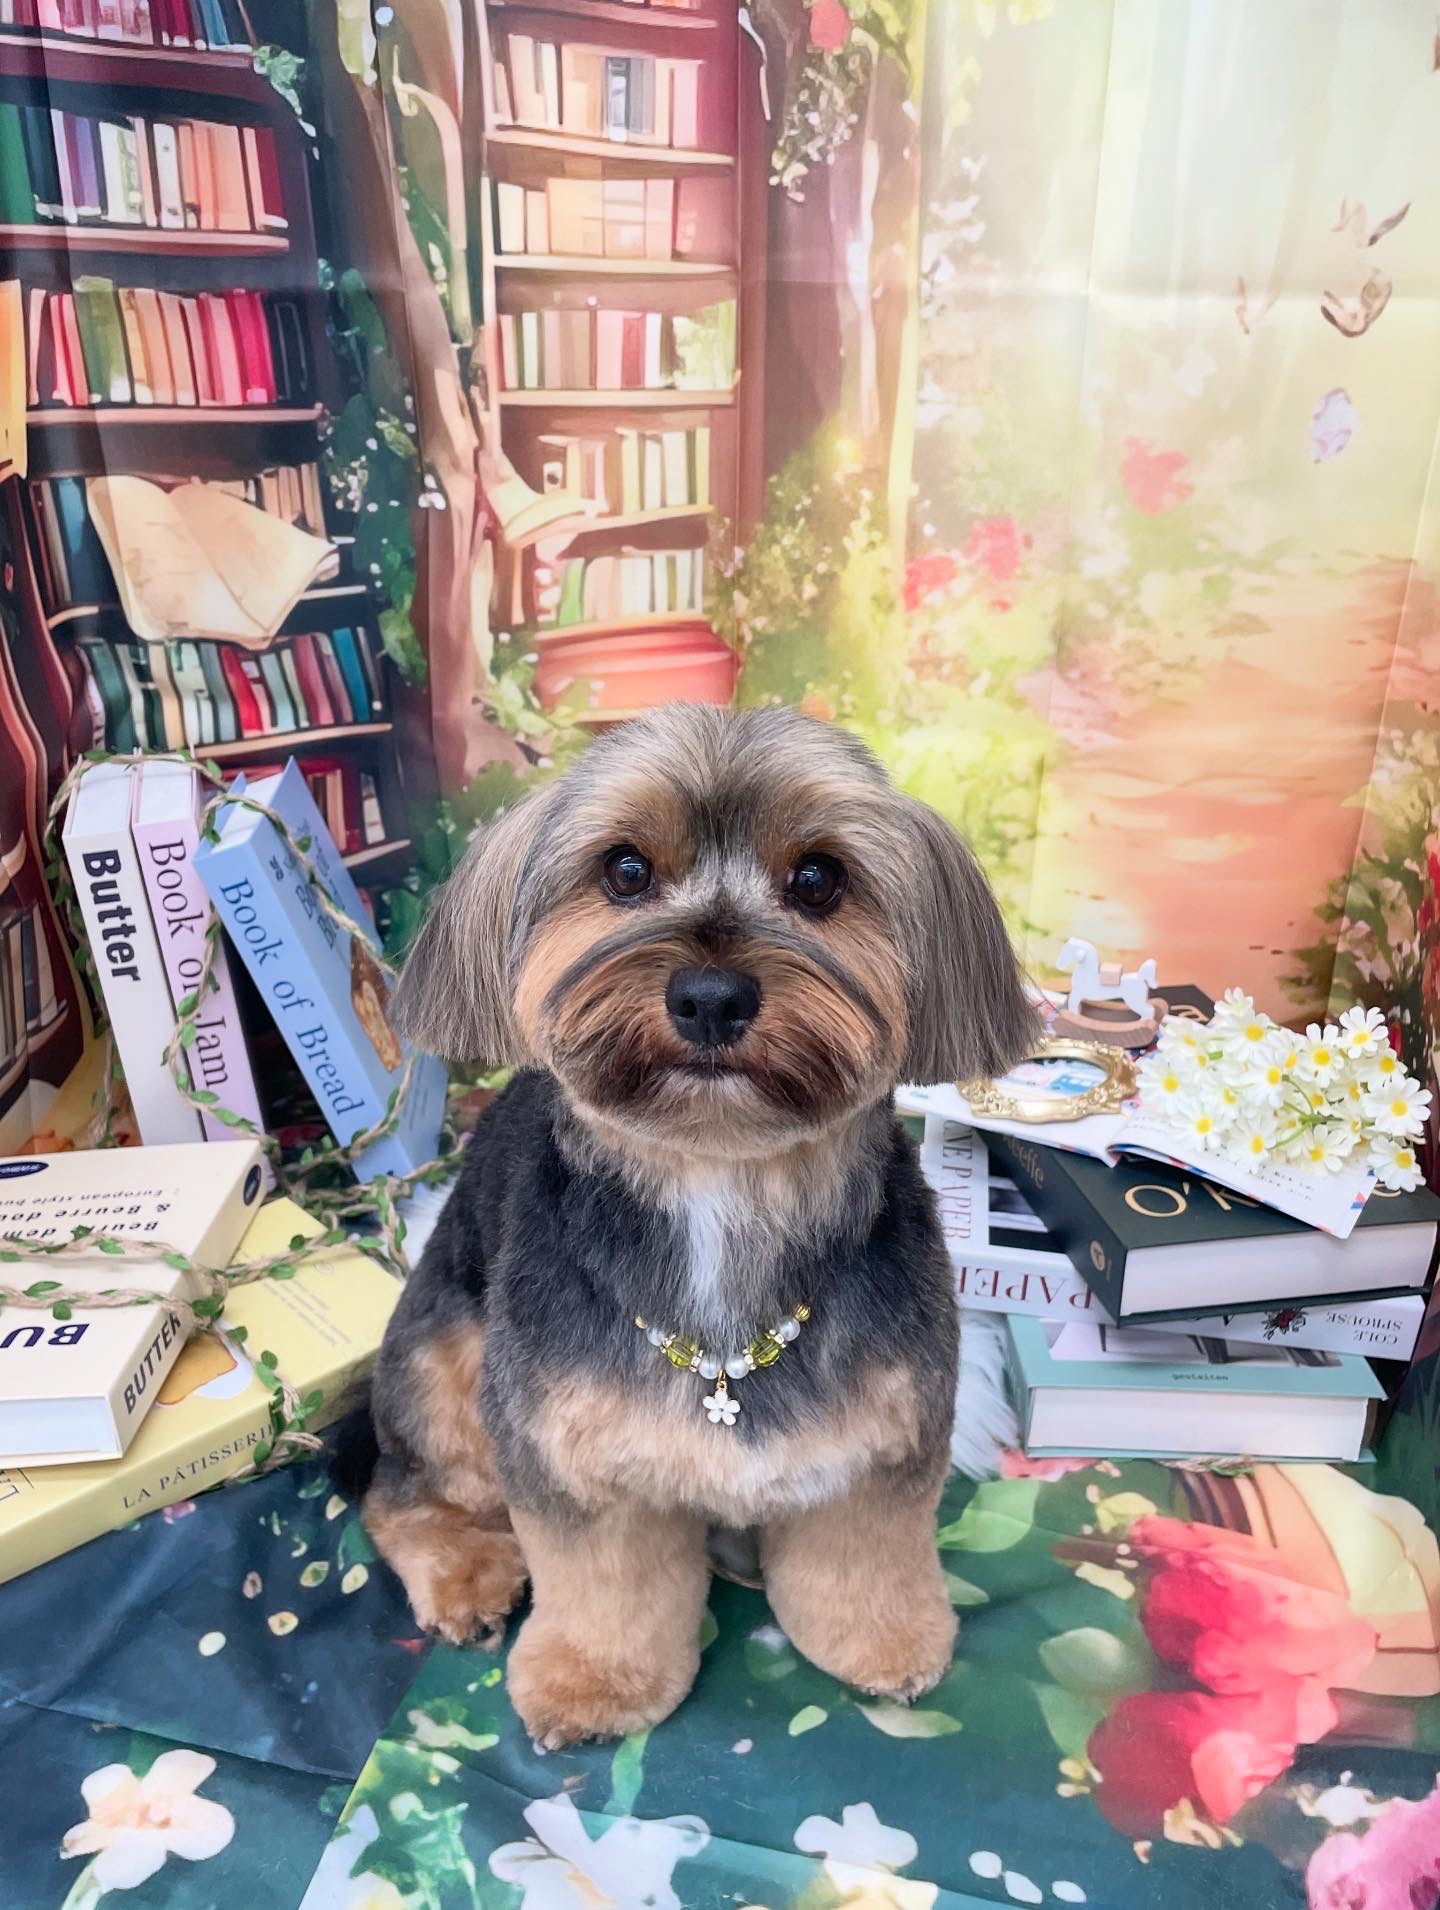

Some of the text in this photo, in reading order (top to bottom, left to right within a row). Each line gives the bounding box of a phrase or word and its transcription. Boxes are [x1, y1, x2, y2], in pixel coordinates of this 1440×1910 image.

[82, 849, 142, 983] Butter
[148, 836, 204, 939] Book
[194, 1012, 229, 1088] Jam
[218, 876, 284, 966] Book
[272, 980, 316, 1012] of
[295, 1023, 365, 1116] Bread
[80, 1189, 164, 1201] European
[941, 1165, 973, 1240] PAPER
[55, 1204, 142, 1219] Beurre
[156, 1202, 171, 1213] &
[70, 1219, 159, 1240] Beur
[1326, 1310, 1403, 1331] SPROUSE
[0, 1323, 90, 1349] BU
[1352, 1329, 1399, 1346] COLE
[122, 1487, 152, 1509] LA
